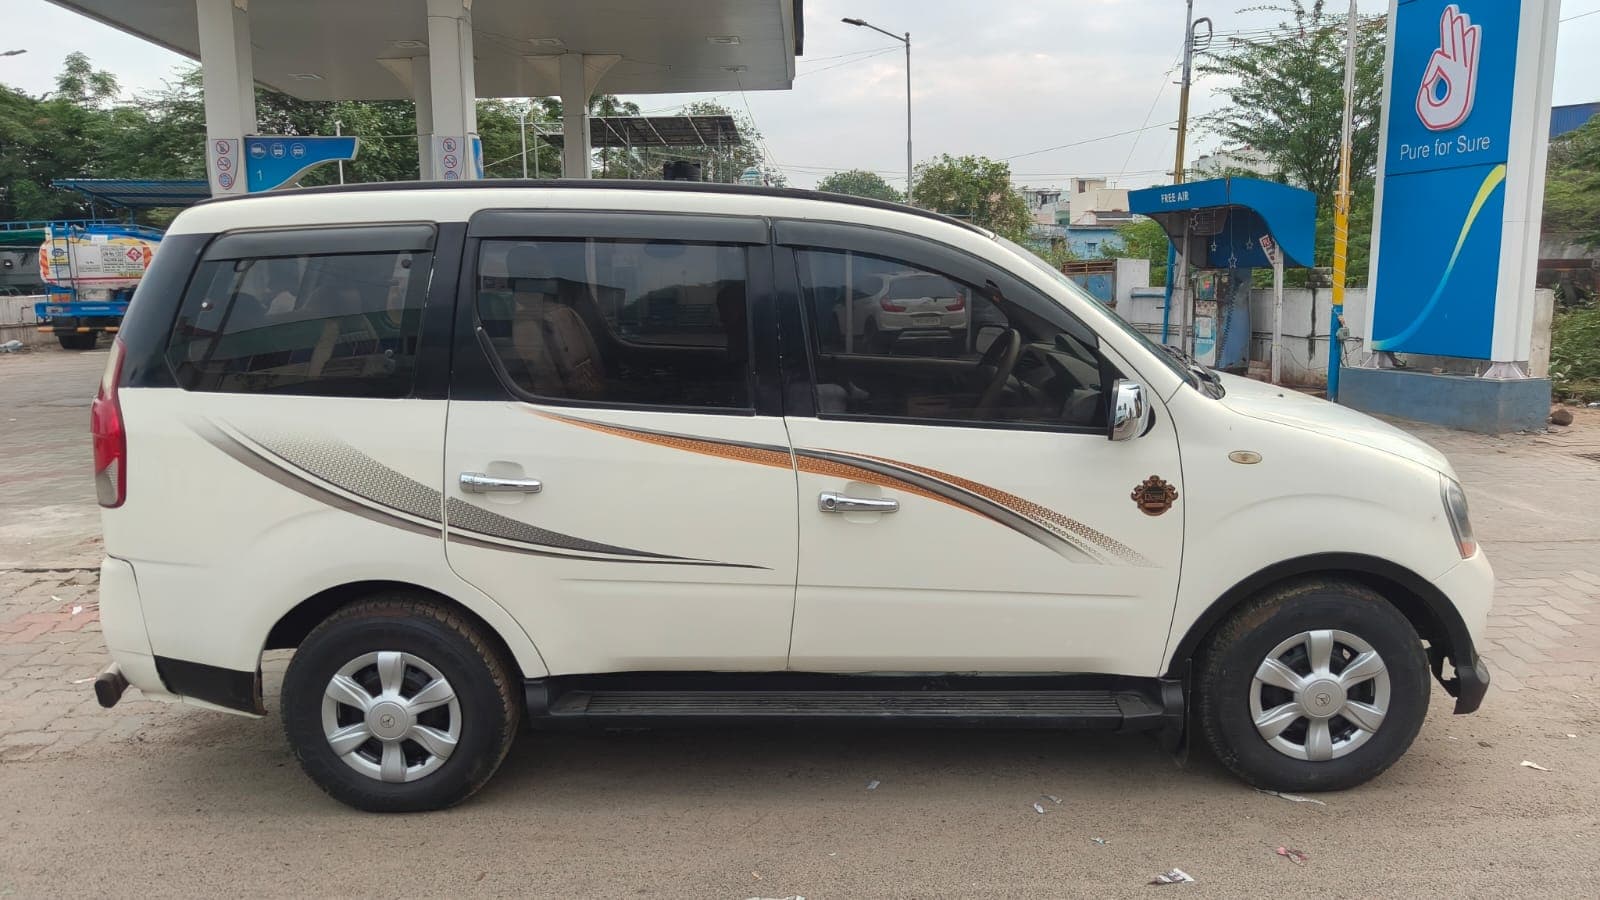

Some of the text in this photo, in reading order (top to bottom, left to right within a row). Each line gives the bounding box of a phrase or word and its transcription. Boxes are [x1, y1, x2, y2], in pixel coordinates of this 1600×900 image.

[1400, 135, 1491, 161] Pure for Sure
[257, 169, 263, 181] 1
[1160, 191, 1190, 204] FREE AIR
